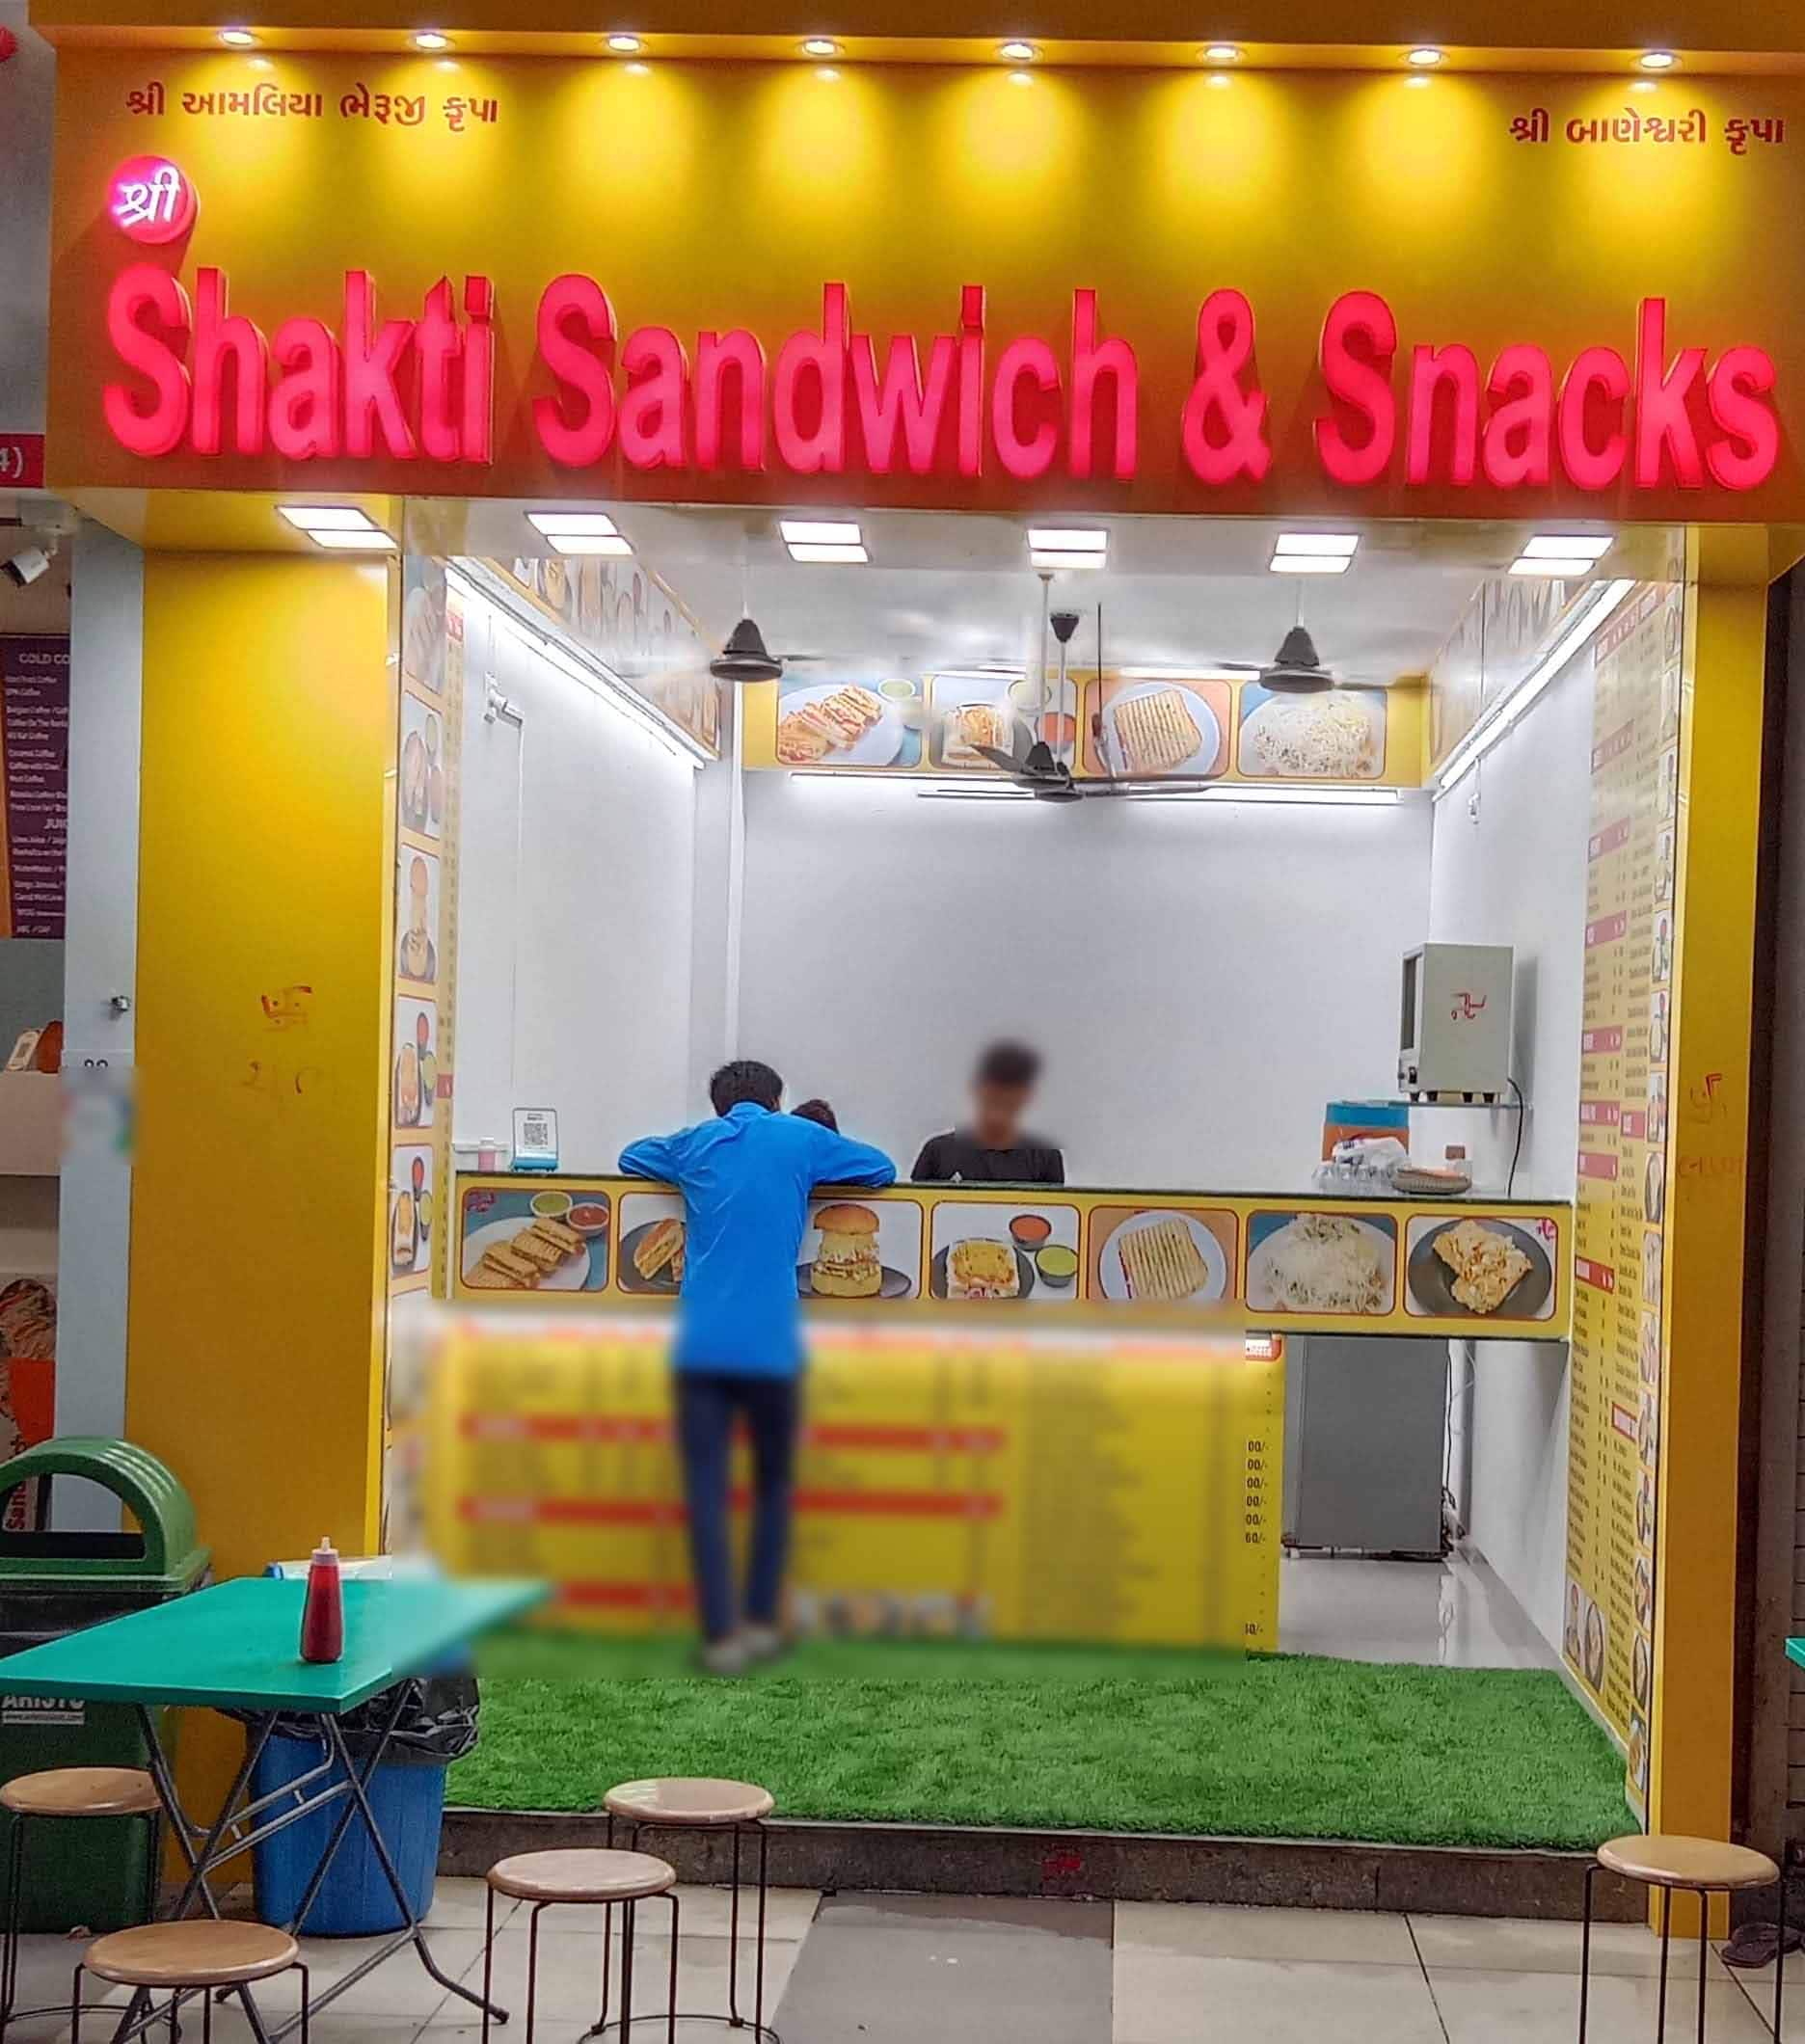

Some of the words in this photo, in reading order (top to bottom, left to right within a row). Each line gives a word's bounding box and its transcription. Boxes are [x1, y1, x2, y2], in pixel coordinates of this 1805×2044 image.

[126, 81, 165, 117] શ્રી
[182, 83, 322, 117] આમલિયા
[444, 96, 498, 131] કૃપા
[1509, 107, 1549, 143] શ્રી
[1566, 107, 1707, 144] બાણેશ્વરી
[1724, 118, 1784, 155] કૃપા
[103, 261, 495, 467] Shakti
[532, 272, 1138, 481] Sandwich
[1182, 288, 1271, 483] &
[1313, 290, 1780, 491] Snacks
[19, 654, 52, 664] COLD
